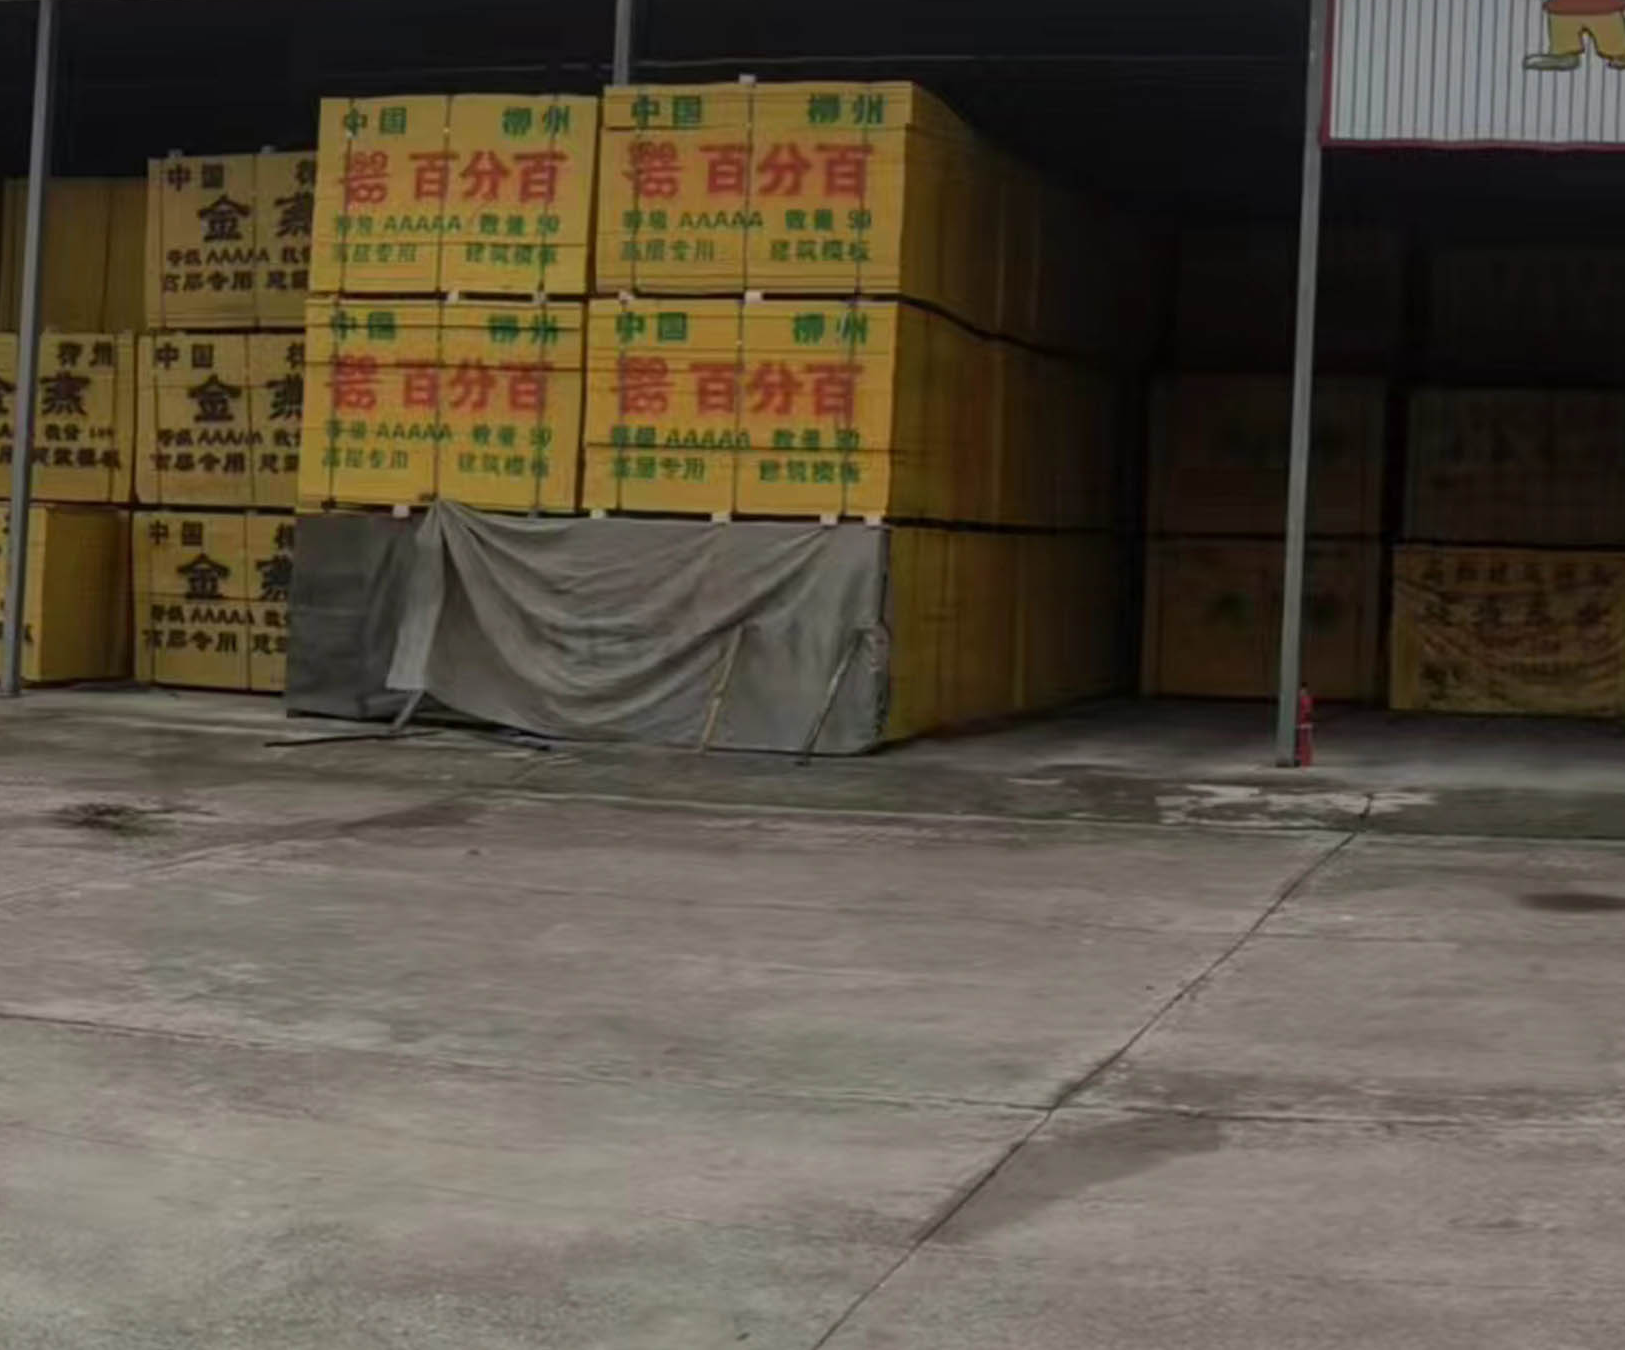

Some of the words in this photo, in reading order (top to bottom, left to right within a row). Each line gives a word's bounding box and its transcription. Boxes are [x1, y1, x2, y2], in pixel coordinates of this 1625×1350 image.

[167, 163, 226, 193] 中国
[408, 149, 570, 204] 百分百
[697, 143, 874, 197] 百分百
[156, 340, 216, 370] 中国
[395, 357, 555, 411] 百分百
[688, 358, 865, 416] 百分百
[148, 520, 205, 547] 中国
